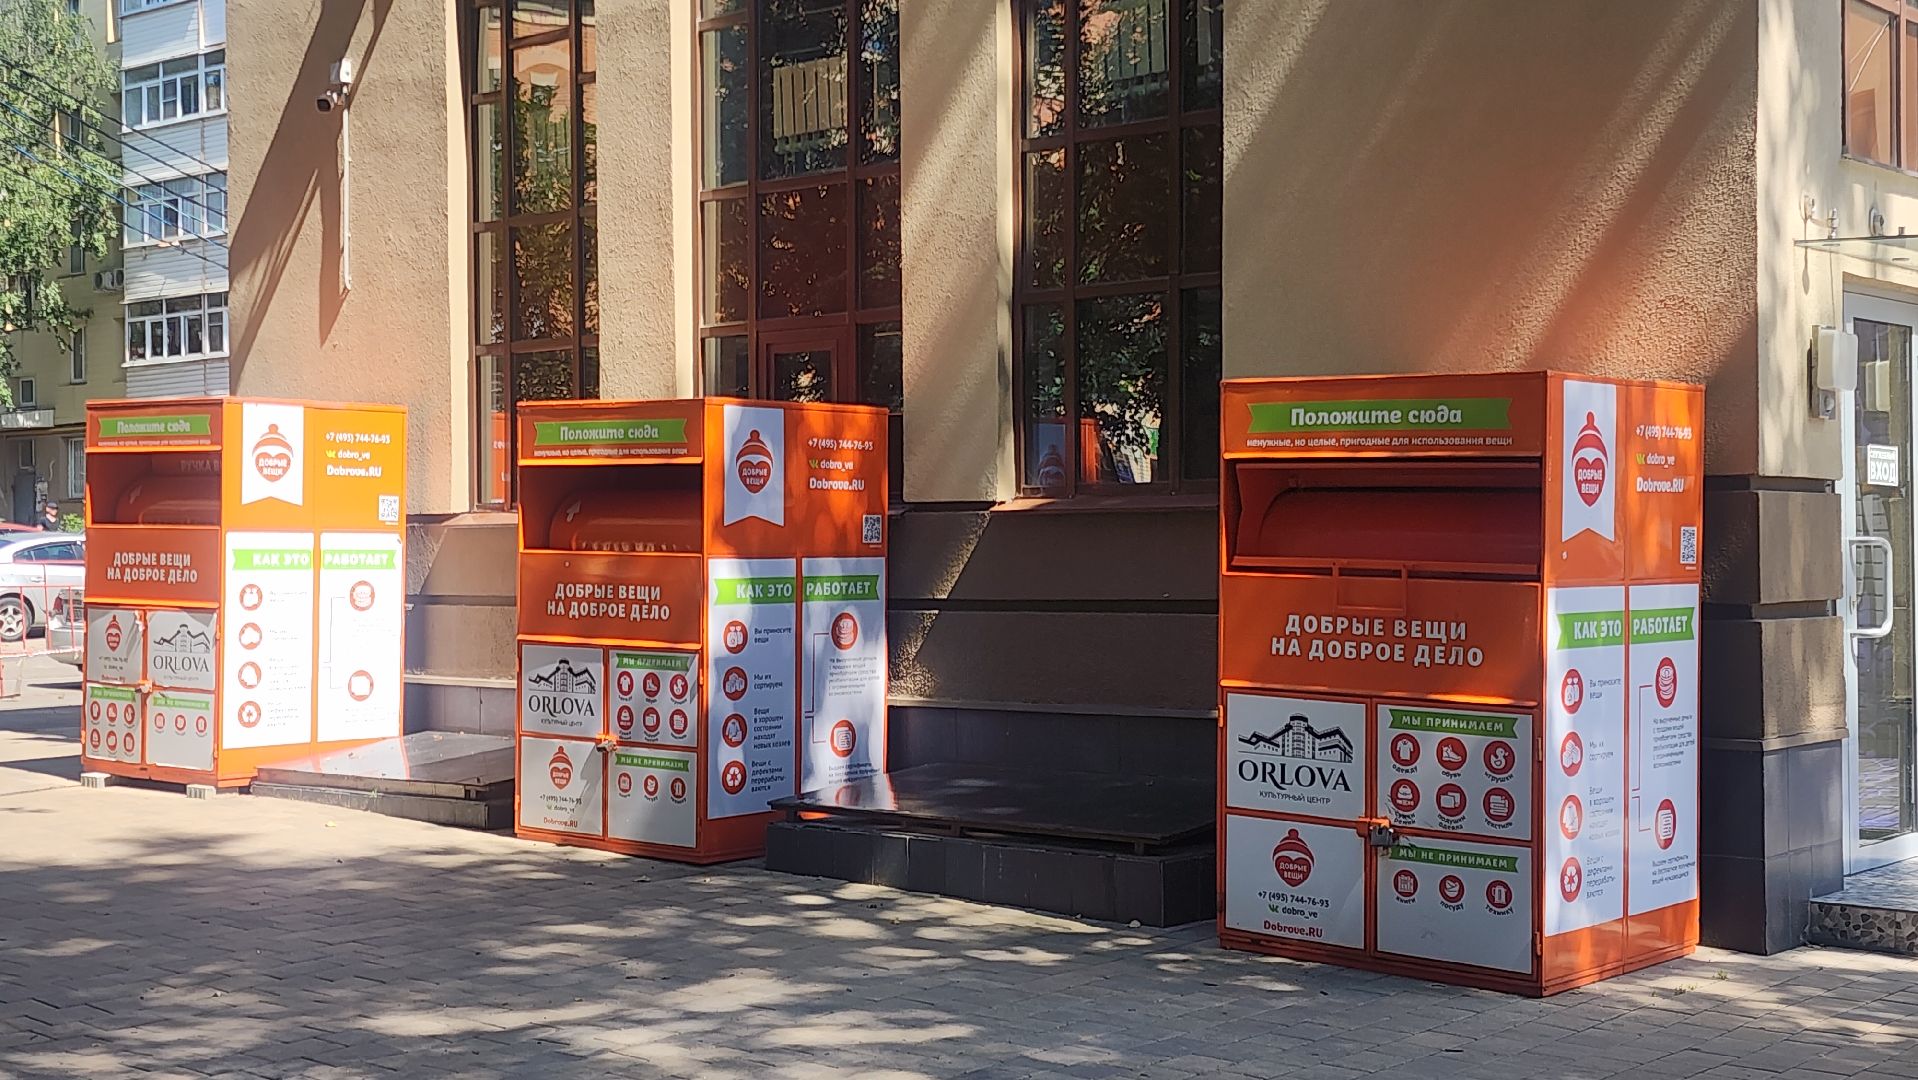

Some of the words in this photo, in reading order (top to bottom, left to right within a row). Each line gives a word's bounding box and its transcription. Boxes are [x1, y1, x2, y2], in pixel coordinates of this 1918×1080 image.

[1290, 408, 1401, 426] Положите
[1408, 405, 1462, 424] сюда
[560, 426, 624, 441] Положите
[628, 424, 659, 438] сюда
[808, 438, 817, 448] +7
[818, 439, 837, 451] (495)
[838, 440, 874, 451] 744-76-93
[1295, 438, 1306, 447] но
[1308, 437, 1338, 448] целые,
[1340, 436, 1391, 448] пригодные
[1391, 437, 1409, 447] для
[1411, 435, 1484, 447] использования
[1486, 435, 1512, 446] вещи
[742, 467, 768, 476] ДОБРЫЕ
[1578, 469, 1602, 481] ДОБРЫЕ
[1870, 461, 1896, 483] ВХОД
[1581, 483, 1599, 494] ВЕЩИ
[114, 552, 157, 567] ДОБРЫЕ
[160, 553, 191, 568] ВЕЩИ
[253, 554, 279, 566] КАК
[285, 553, 309, 566] ЭТО
[324, 553, 388, 566] РАБОТАЕТ
[107, 567, 121, 580] НА
[123, 568, 165, 583] ДОБРОЕ
[167, 569, 198, 585] ДЕЛО
[555, 583, 614, 600] ДОБРЫЕ
[618, 585, 661, 603] ВЕЩИ
[736, 584, 763, 599] КАК
[767, 583, 792, 597] ЭТО
[806, 582, 871, 596] РАБОТАЕТ
[547, 600, 565, 616] НА
[569, 601, 626, 619] ДОБРОЕ
[630, 604, 670, 622] ДЕЛО
[754, 628, 763, 636] Вы
[764, 627, 792, 636] приносите
[1285, 614, 1385, 636] ДОБРЫЕ
[1393, 619, 1467, 644] ВЕЩИ
[1574, 621, 1598, 640] КАК
[1600, 619, 1622, 638] ЭТО
[1633, 615, 1688, 635] РАБОТАЕТ
[1271, 637, 1301, 656] НА
[1308, 639, 1405, 662] ДОБРОЕ
[1413, 644, 1484, 668] ДЕЛО
[154, 655, 209, 674] ORLOVA
[754, 681, 783, 691] сортируем
[529, 695, 595, 717] ORLOVA
[754, 707, 770, 716] Вещи
[1402, 715, 1421, 725] МЫ
[1426, 717, 1504, 732] ПРИНИМАЕМ
[751, 768, 783, 777] дефектами
[1238, 759, 1352, 792] ORLOVA
[1392, 763, 1418, 774] одежду
[1441, 770, 1462, 779] обувь
[1484, 771, 1514, 784] игрушки
[1260, 790, 1305, 802] КУЛЬТУРНЫЙ
[1306, 795, 1331, 805] ЦЕНТР
[1484, 817, 1513, 830] текстиль
[1399, 848, 1416, 858] МЫ
[1421, 851, 1434, 860] НЕ
[1438, 852, 1508, 868] ПРИНИМАЕМ
[1280, 862, 1307, 873] ДОБРЫЕ
[1258, 891, 1267, 899] +7
[1268, 891, 1288, 904] (495)
[1290, 895, 1329, 908] 744-76-93
[1439, 900, 1464, 912] посуду
[1485, 904, 1514, 916] технику
